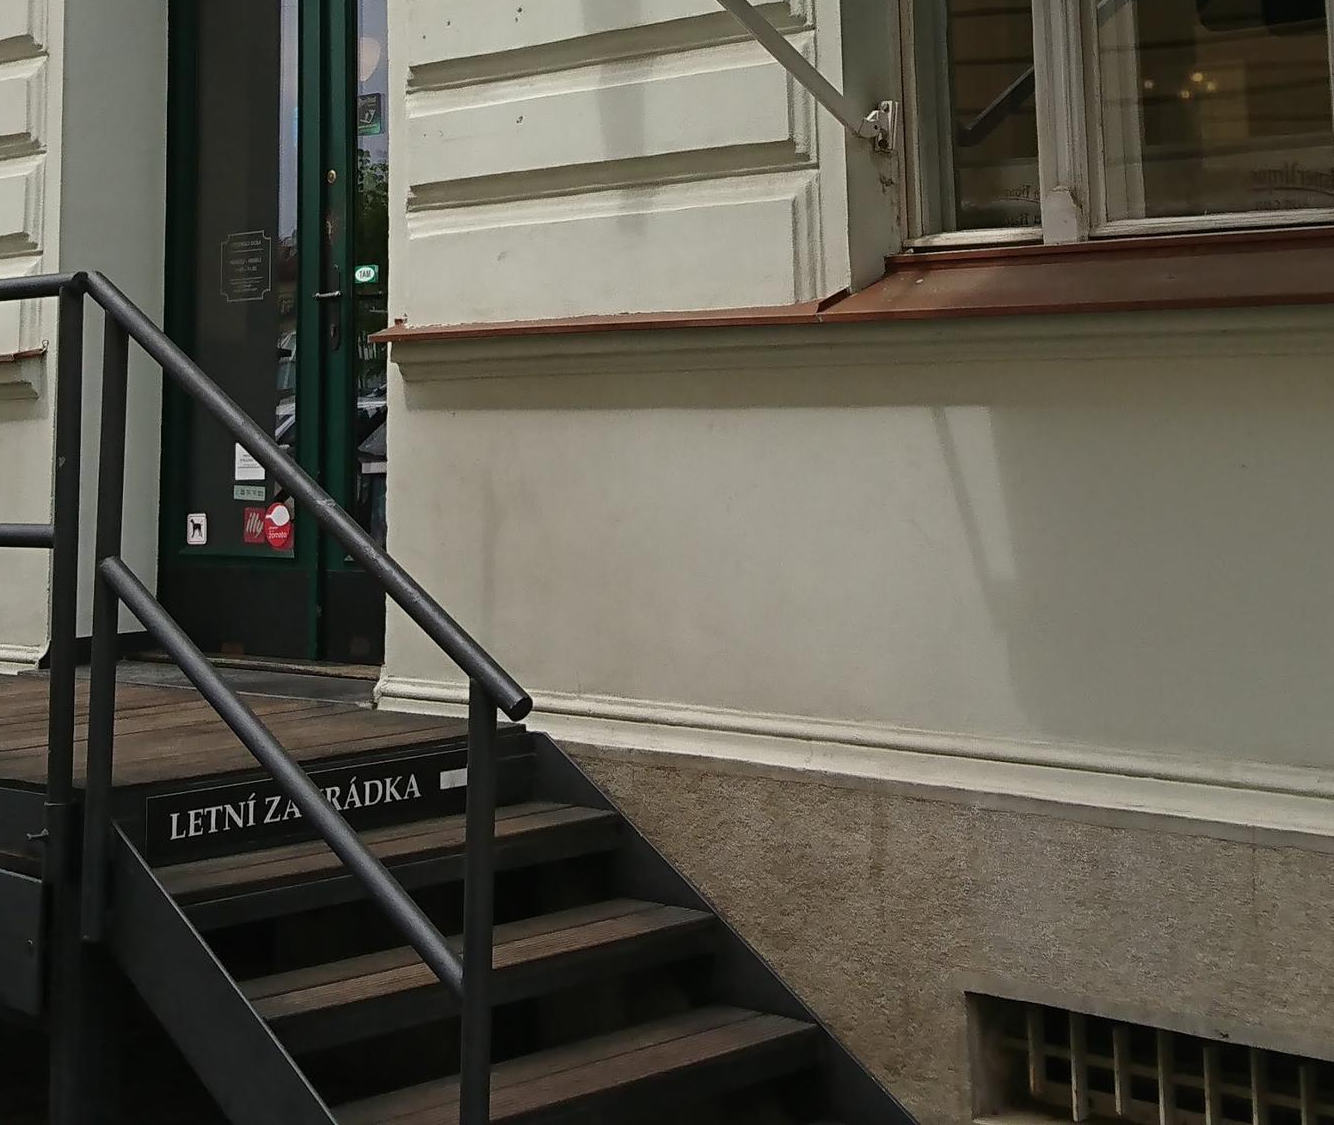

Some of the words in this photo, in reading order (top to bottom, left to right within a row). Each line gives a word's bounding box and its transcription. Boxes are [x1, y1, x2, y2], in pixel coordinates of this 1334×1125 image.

[245, 511, 264, 539] illy
[268, 531, 288, 539] zomato
[169, 791, 257, 841] LETNÍ
[263, 773, 422, 824] ZARÁDKA
